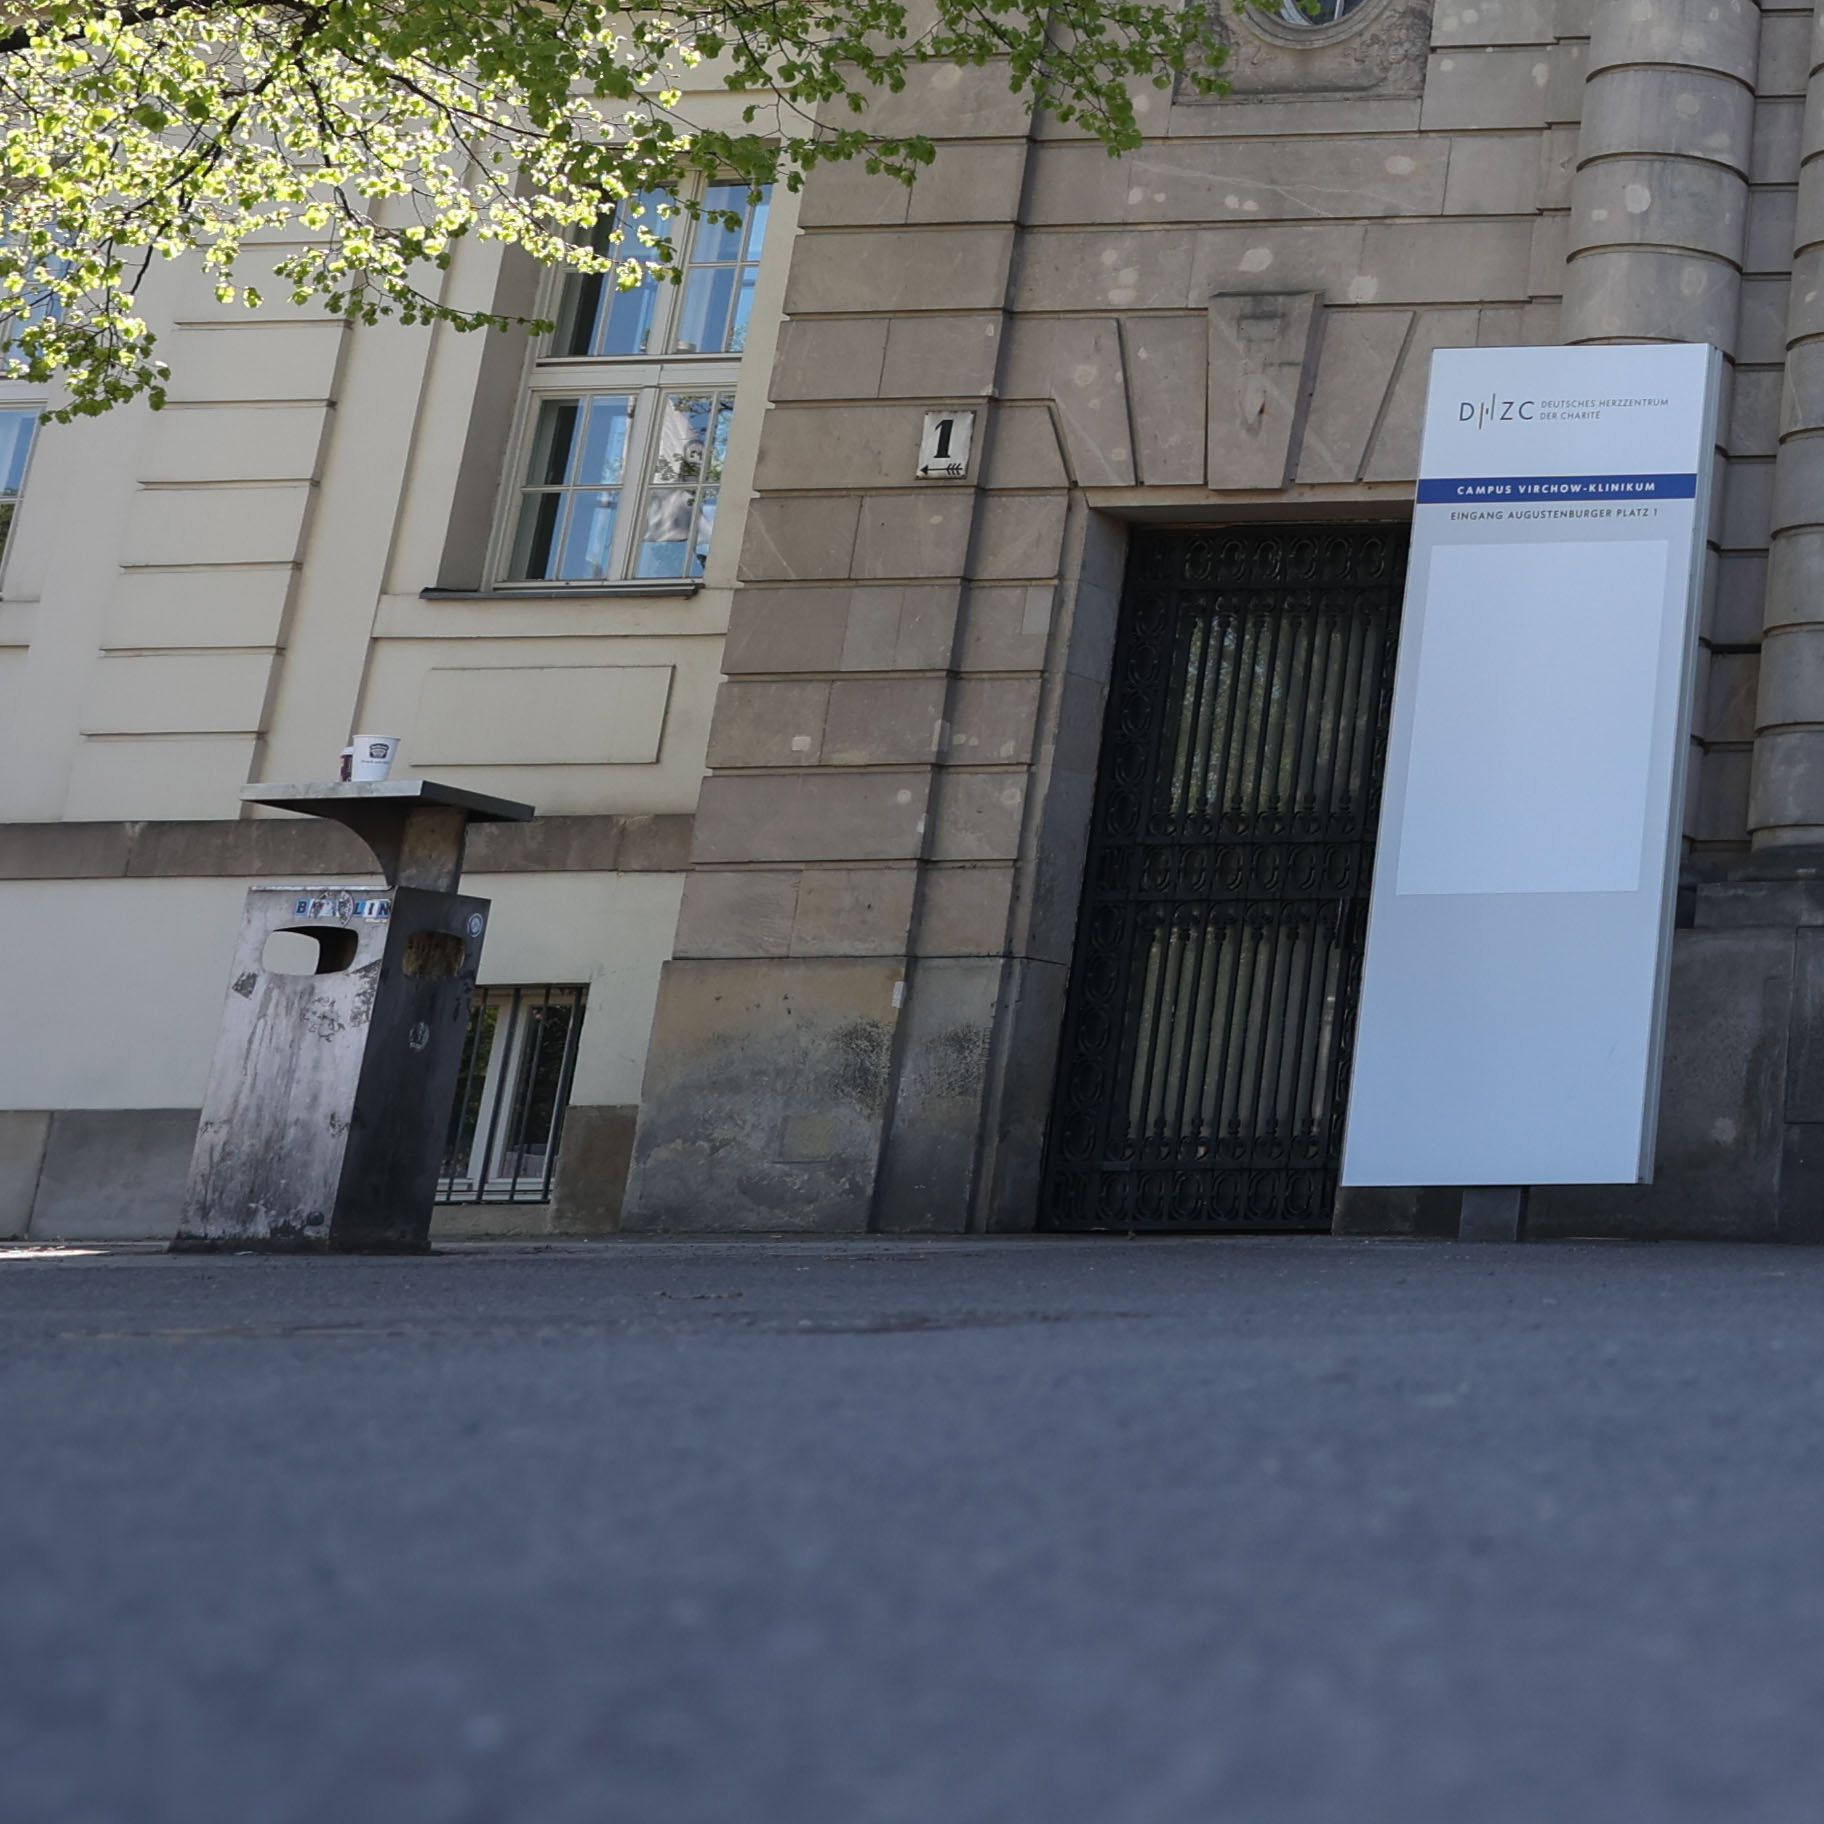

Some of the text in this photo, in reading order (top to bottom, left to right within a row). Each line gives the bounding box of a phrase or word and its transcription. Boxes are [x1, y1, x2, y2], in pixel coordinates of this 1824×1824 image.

[1540, 397, 1670, 409] DEUTSCHES HERZZENTRUM
[1539, 411, 1558, 421] DER
[933, 419, 954, 458] 1
[1456, 482, 1656, 495] CAMPUS VIRCHOW-KLINIKUM
[1450, 507, 1658, 521] EINGANG AUGUSTENBURGER PLATZ 1
